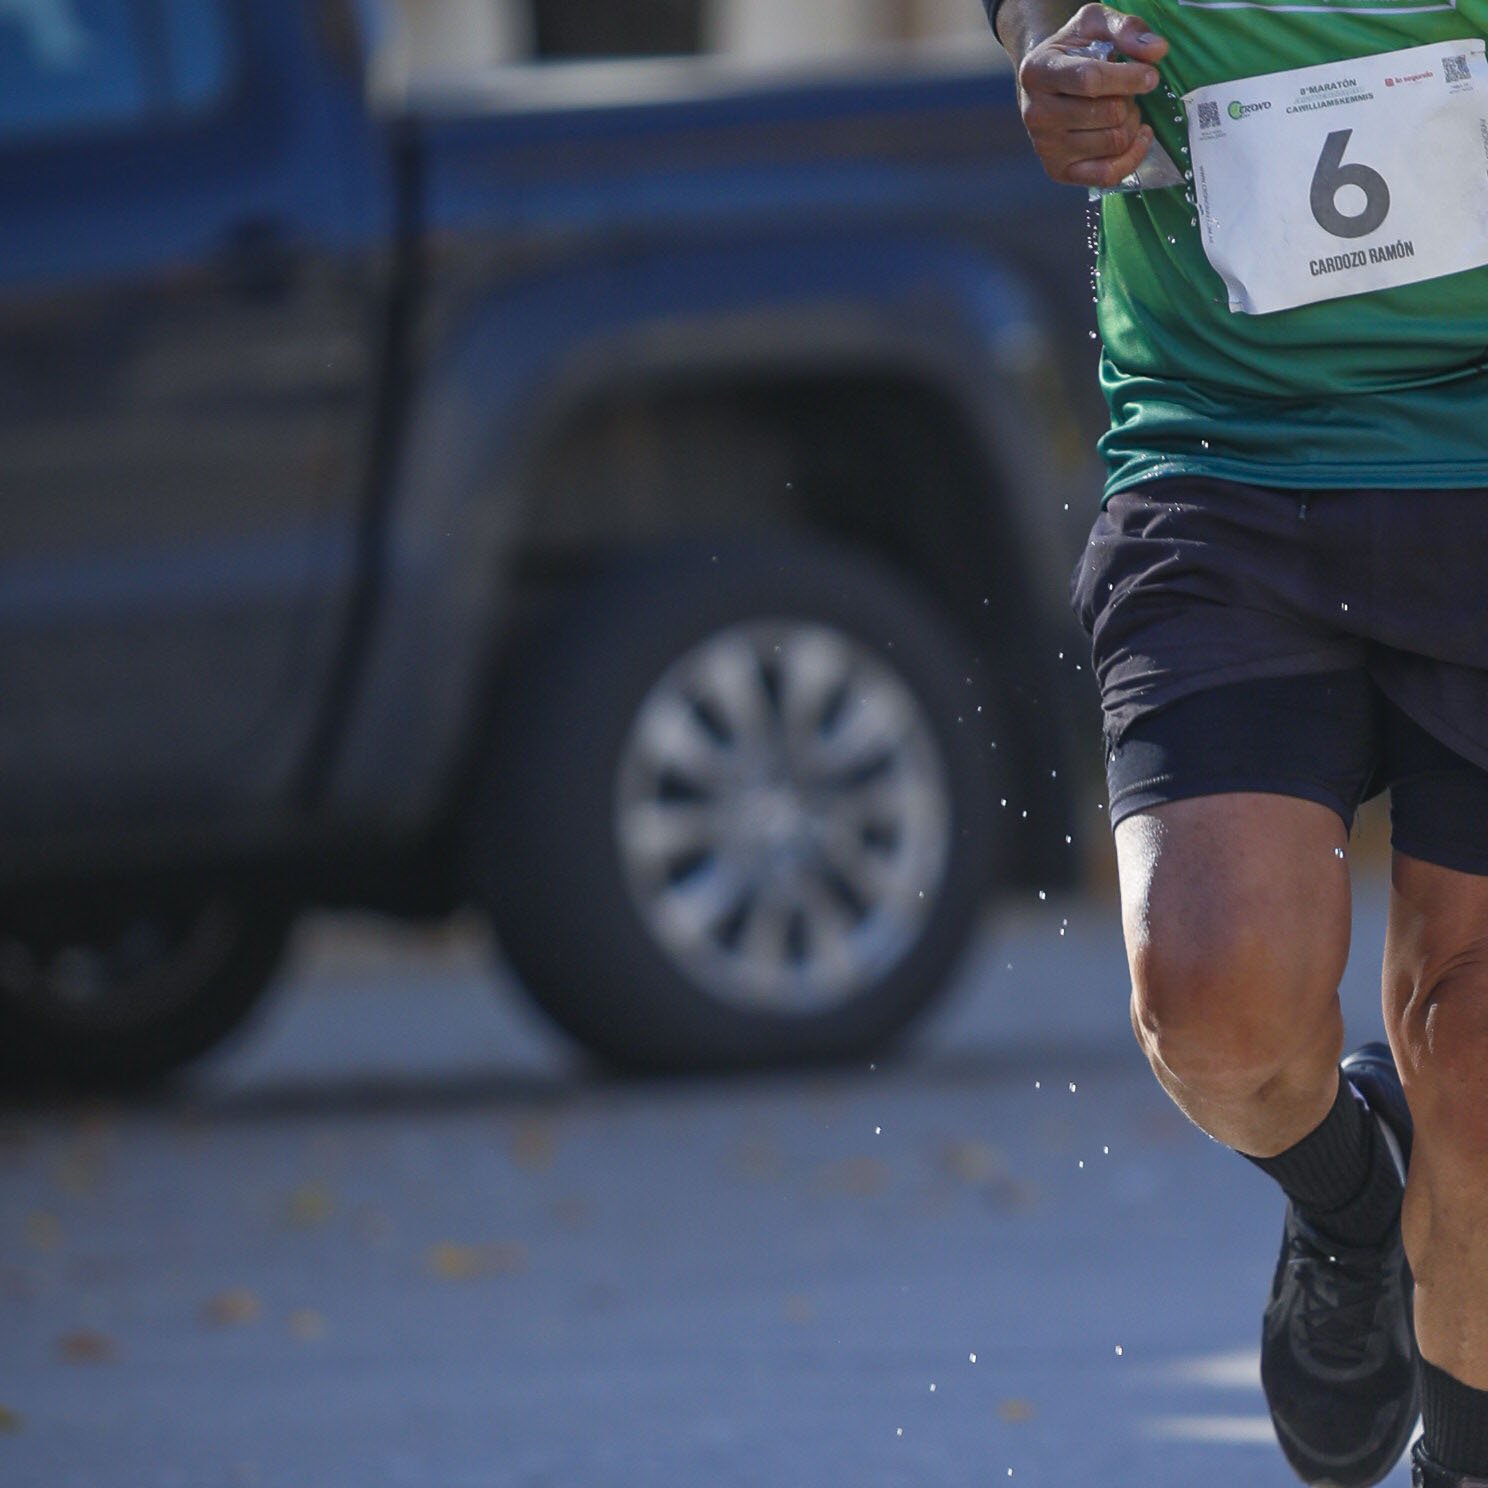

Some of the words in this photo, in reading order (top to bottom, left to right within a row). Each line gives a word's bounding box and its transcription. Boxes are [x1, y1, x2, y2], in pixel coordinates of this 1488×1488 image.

[1286, 93, 1374, 114] CAWILLIAMSKEMMIS
[1309, 128, 1391, 239] 6
[1309, 250, 1368, 277] CARDOZO
[1368, 240, 1415, 264] RAMÓN
